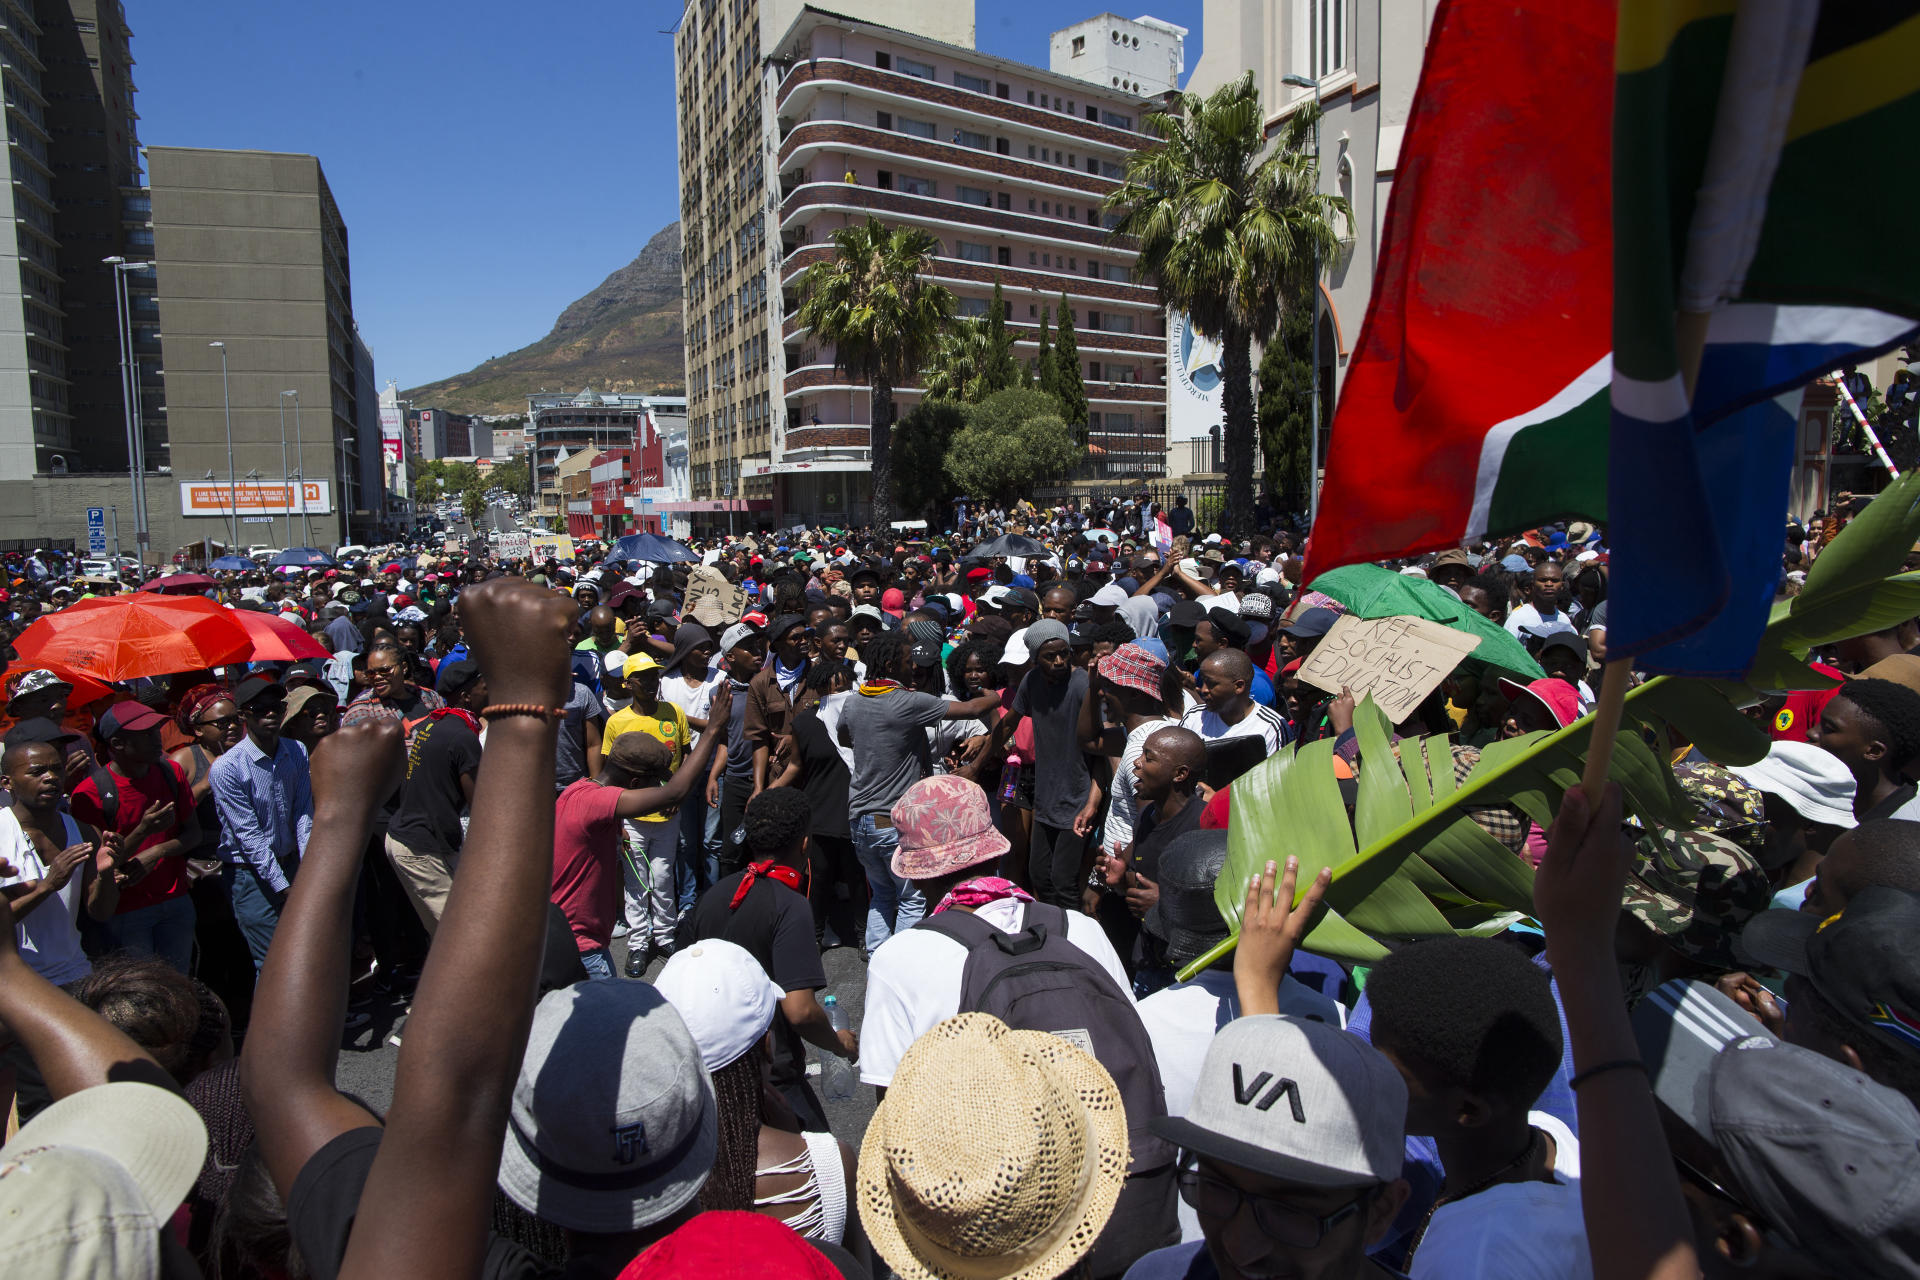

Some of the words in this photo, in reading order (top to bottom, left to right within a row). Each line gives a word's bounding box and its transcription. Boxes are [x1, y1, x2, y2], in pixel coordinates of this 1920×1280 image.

[91, 511, 99, 519] P
[508, 546, 523, 556] US
[728, 586, 745, 617] LACK
[1354, 617, 1420, 649] REE
[1328, 630, 1441, 689] SOCIALIST
[1306, 649, 1422, 712] EDUCATION
[1233, 1062, 1306, 1123] VA
